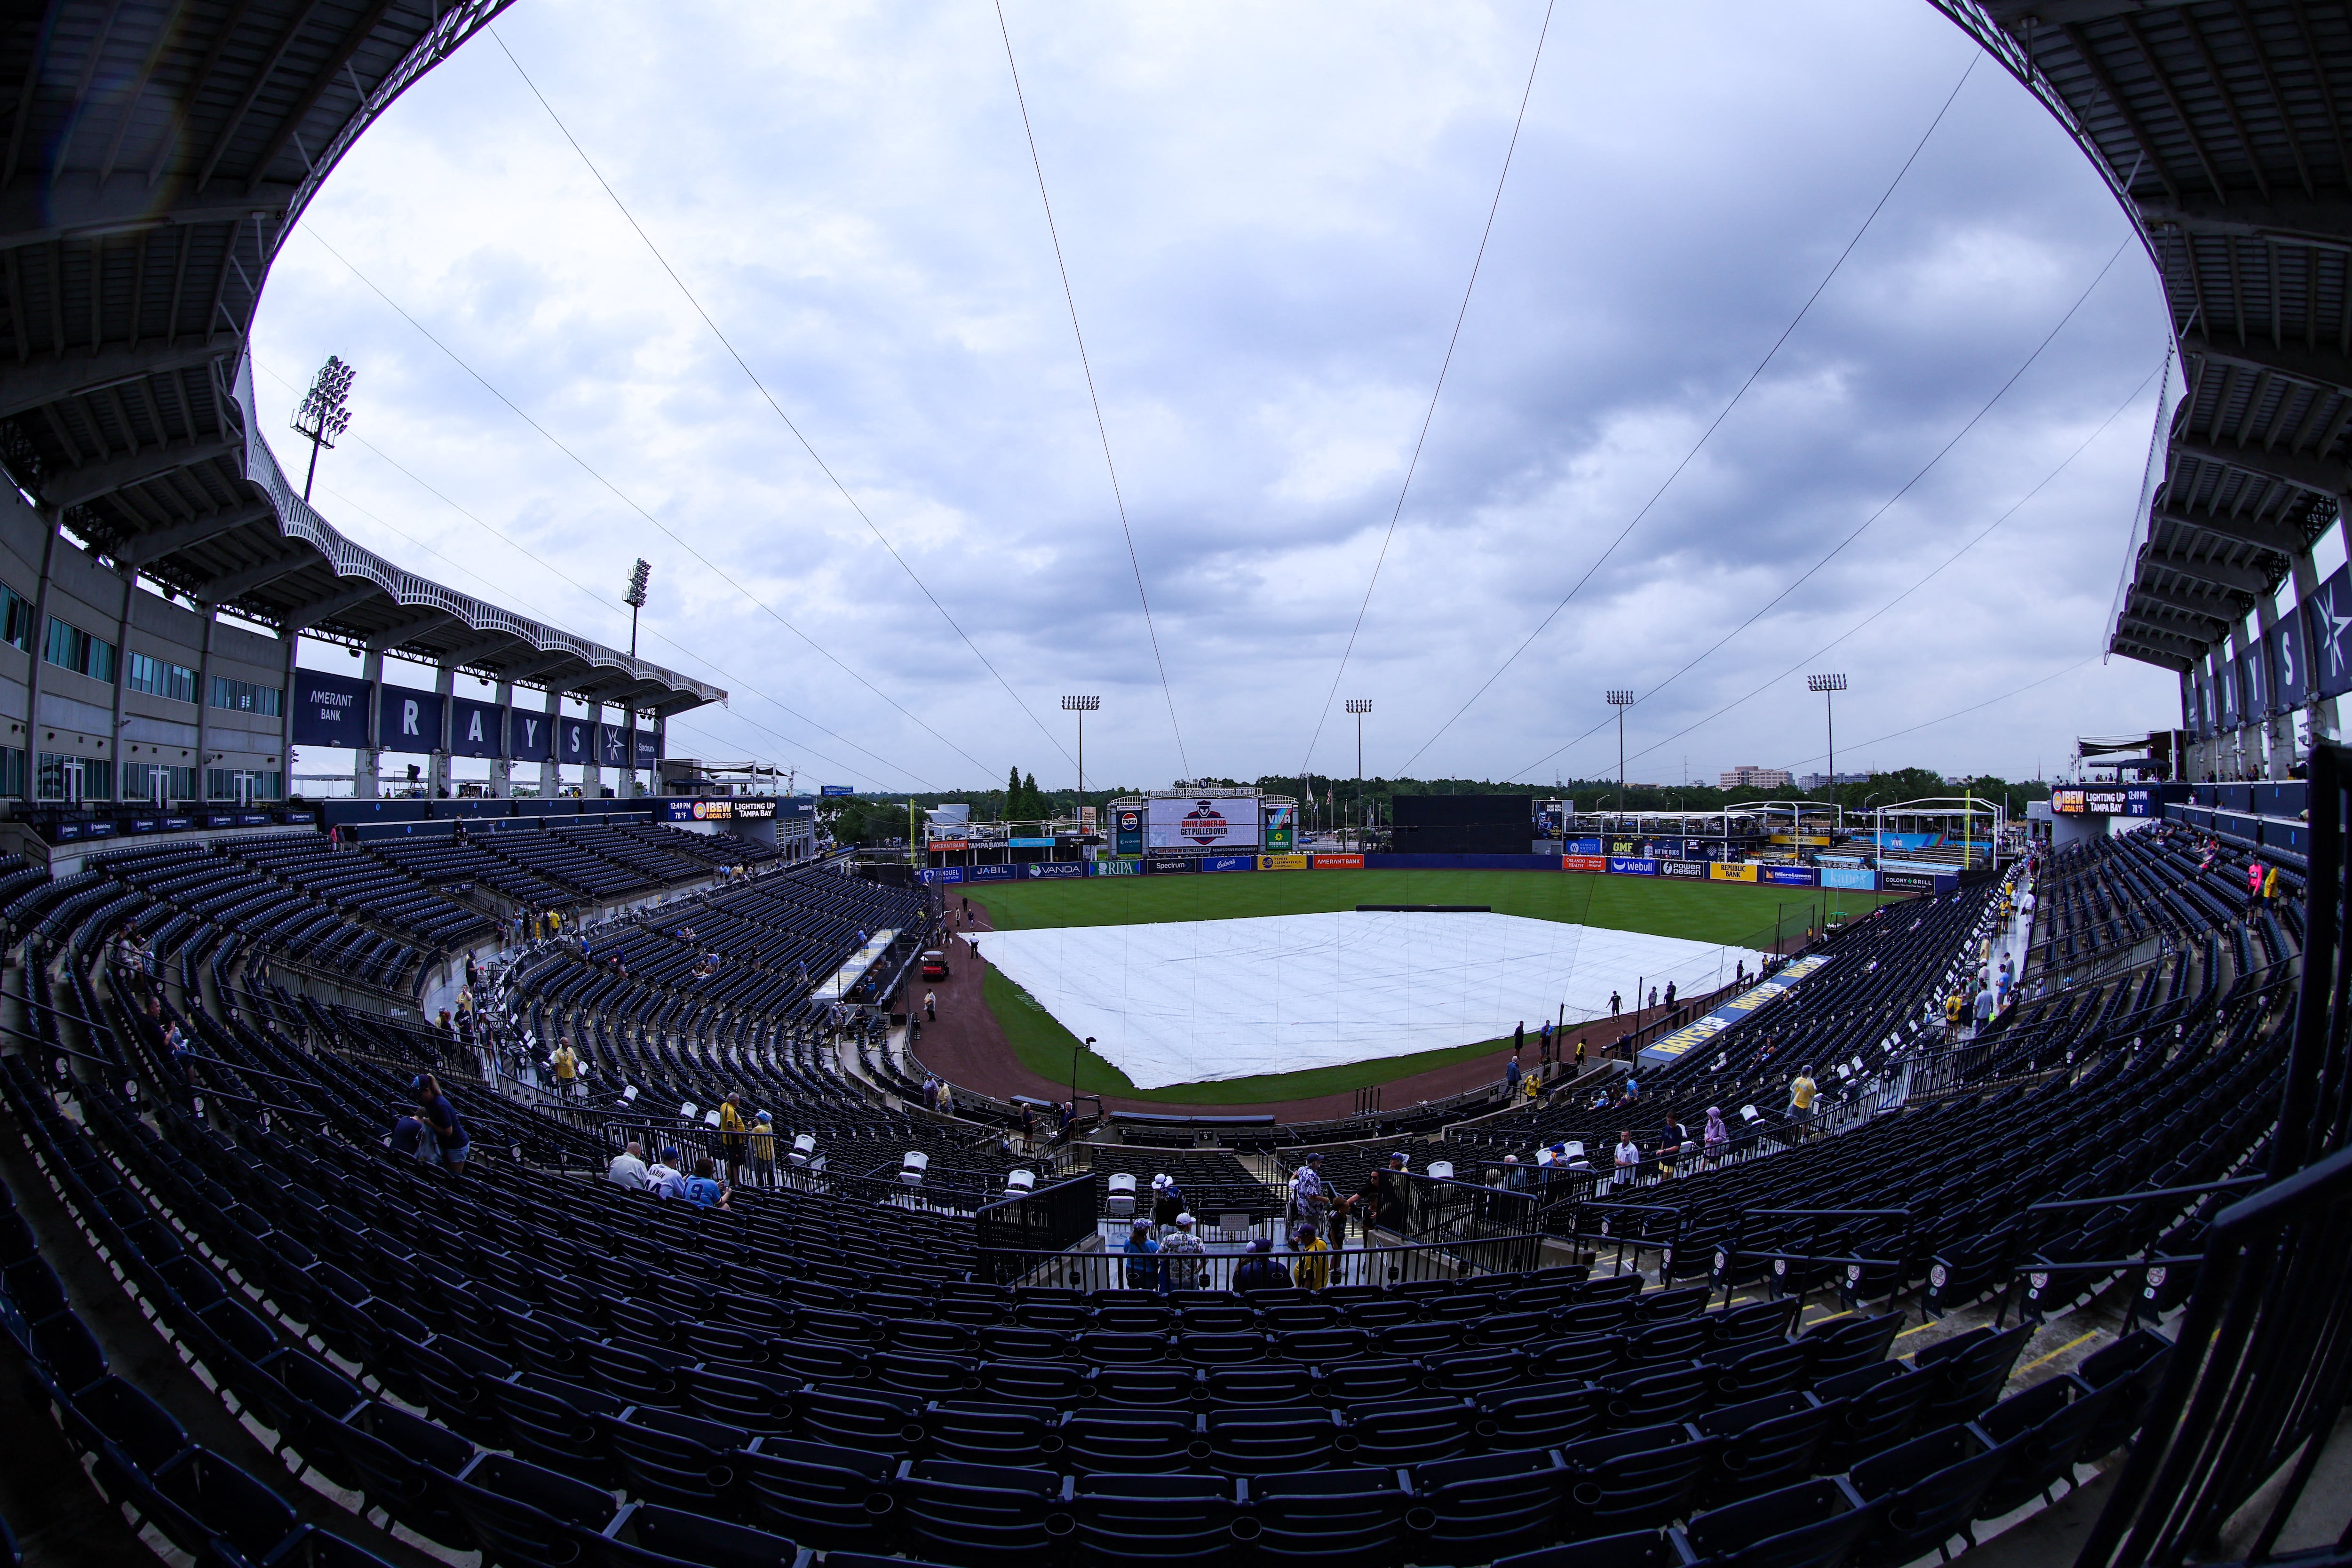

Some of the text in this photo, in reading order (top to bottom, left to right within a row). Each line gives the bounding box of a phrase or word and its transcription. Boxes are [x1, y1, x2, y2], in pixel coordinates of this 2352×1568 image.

[310, 690, 353, 707] AMERANT
[321, 708, 341, 721] BANK
[638, 743, 653, 752] Spectrum
[2062, 791, 2084, 804] IBEW
[2128, 791, 2147, 800] 12:49 PM
[706, 802, 731, 812] IBEW
[2090, 802, 2122, 812] TAMPA BAY
[1268, 815, 1291, 823] VIVA
[1613, 842, 1633, 852] GMF
[1108, 862, 1134, 875] RIPA
[1216, 859, 1236, 869] Culver's
[1627, 861, 1652, 872] Webull
[1831, 870, 1866, 884] kane's
[1780, 963, 1820, 978] RAYS
[1725, 992, 1778, 1011] RAYS
[1650, 1027, 1717, 1055] RAYS
[649, 1169, 666, 1179] AARON
[682, 1182, 704, 1201] 19
